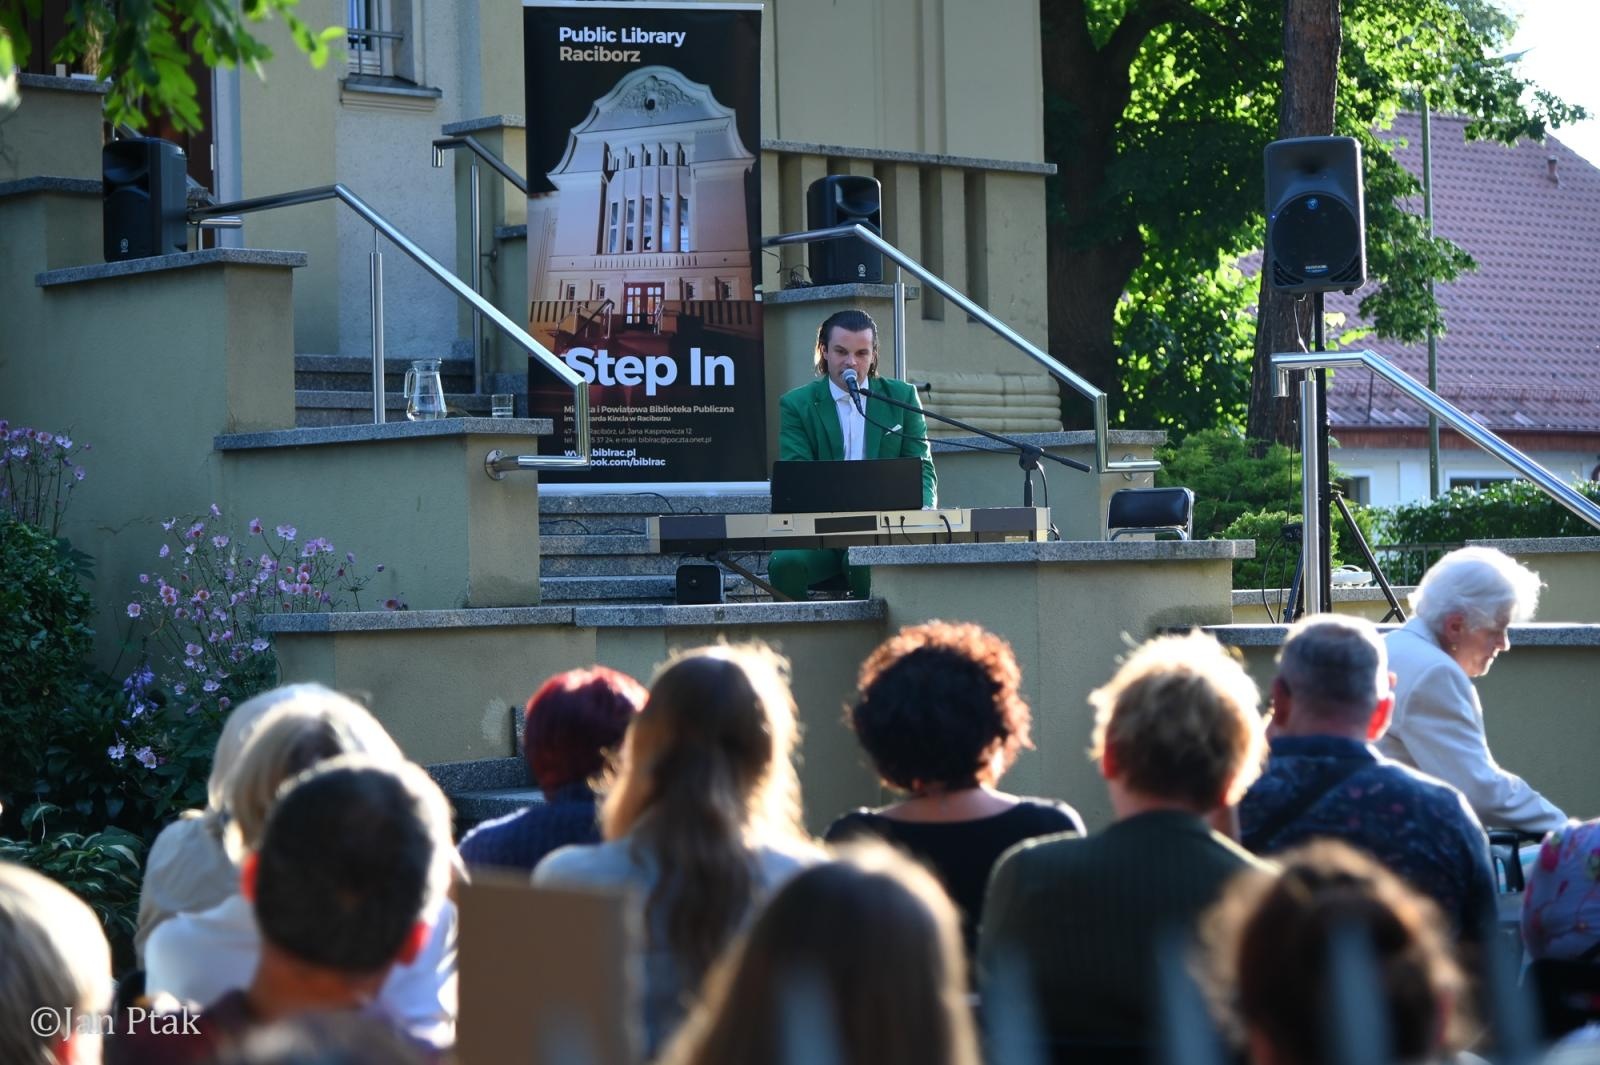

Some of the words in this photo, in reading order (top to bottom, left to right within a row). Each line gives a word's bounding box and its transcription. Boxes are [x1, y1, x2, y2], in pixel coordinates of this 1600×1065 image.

[559, 26, 617, 42] Public
[621, 26, 686, 47] Library
[560, 45, 640, 62] Raciborz
[565, 347, 678, 396] Step
[690, 347, 735, 386] In
[601, 405, 648, 413] Powiatowa
[649, 404, 692, 413] Biblioteka
[693, 404, 735, 413] Publiczna
